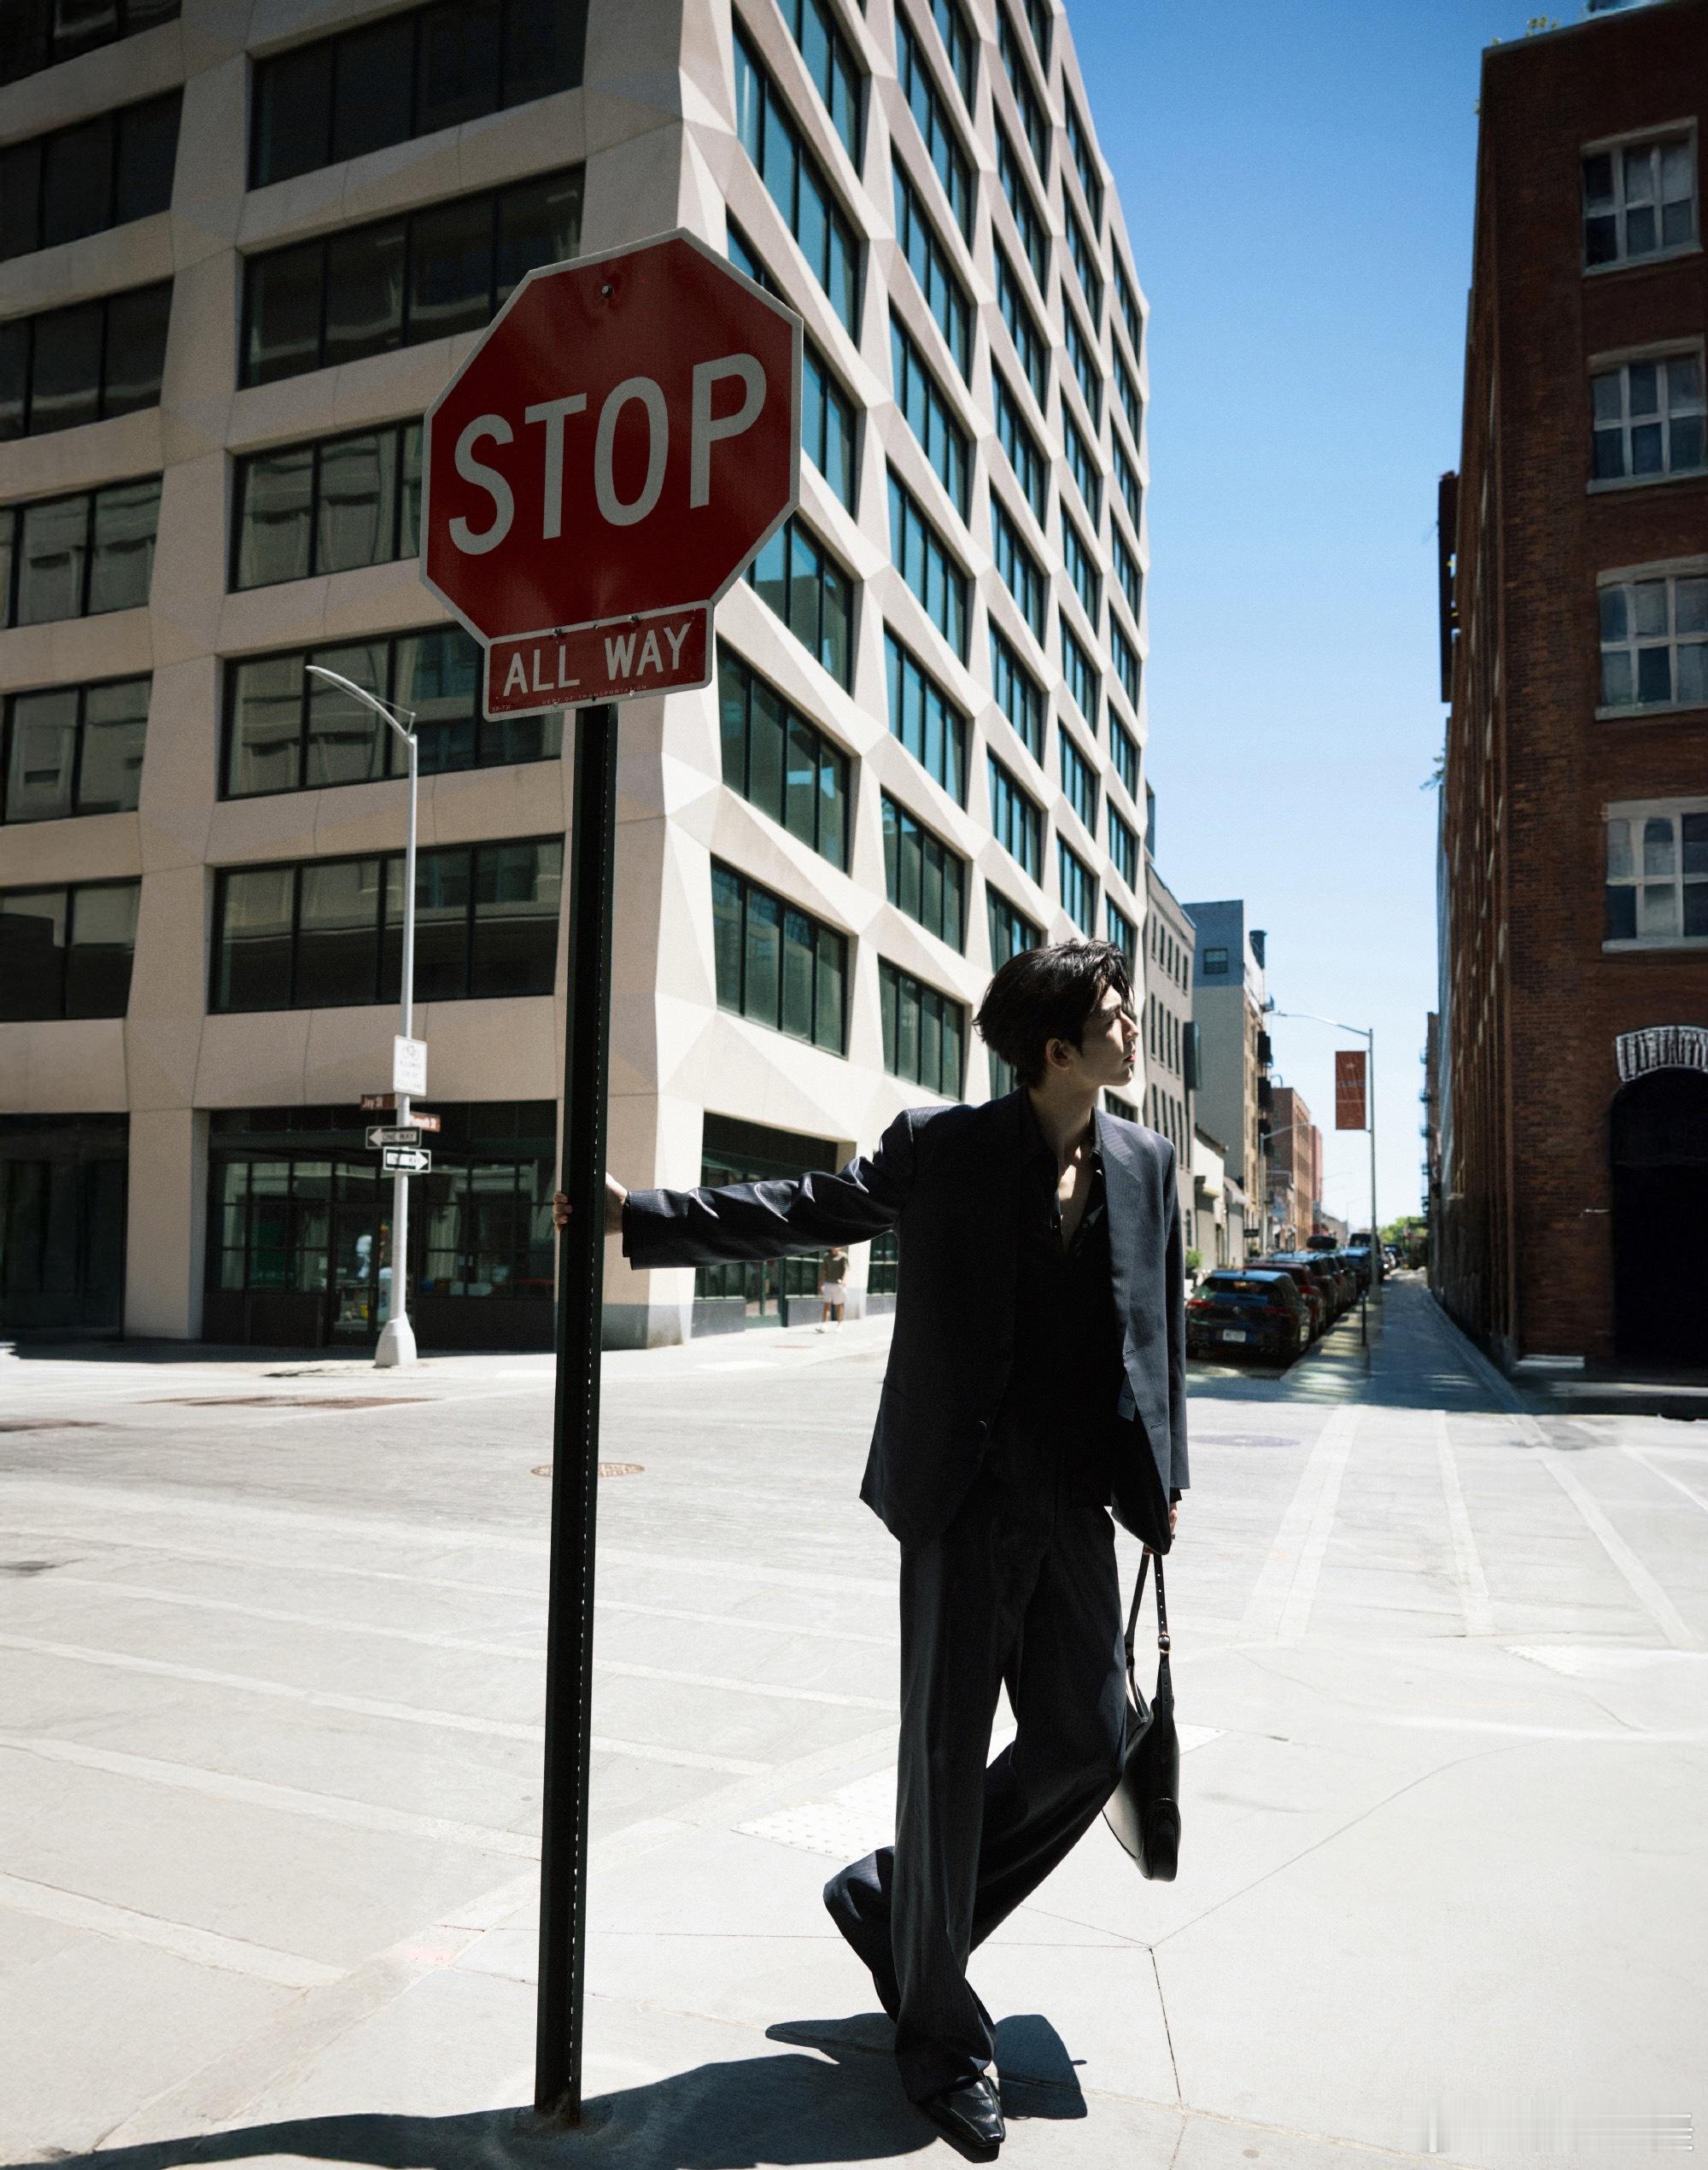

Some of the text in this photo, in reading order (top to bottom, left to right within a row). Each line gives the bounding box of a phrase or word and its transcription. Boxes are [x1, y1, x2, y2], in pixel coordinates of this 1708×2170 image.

[448, 353, 767, 555] STOP
[503, 622, 693, 697] ALL WAY
[578, 685, 646, 699] TRANSPORTATION
[383, 1132, 414, 1142] ONE WAY
